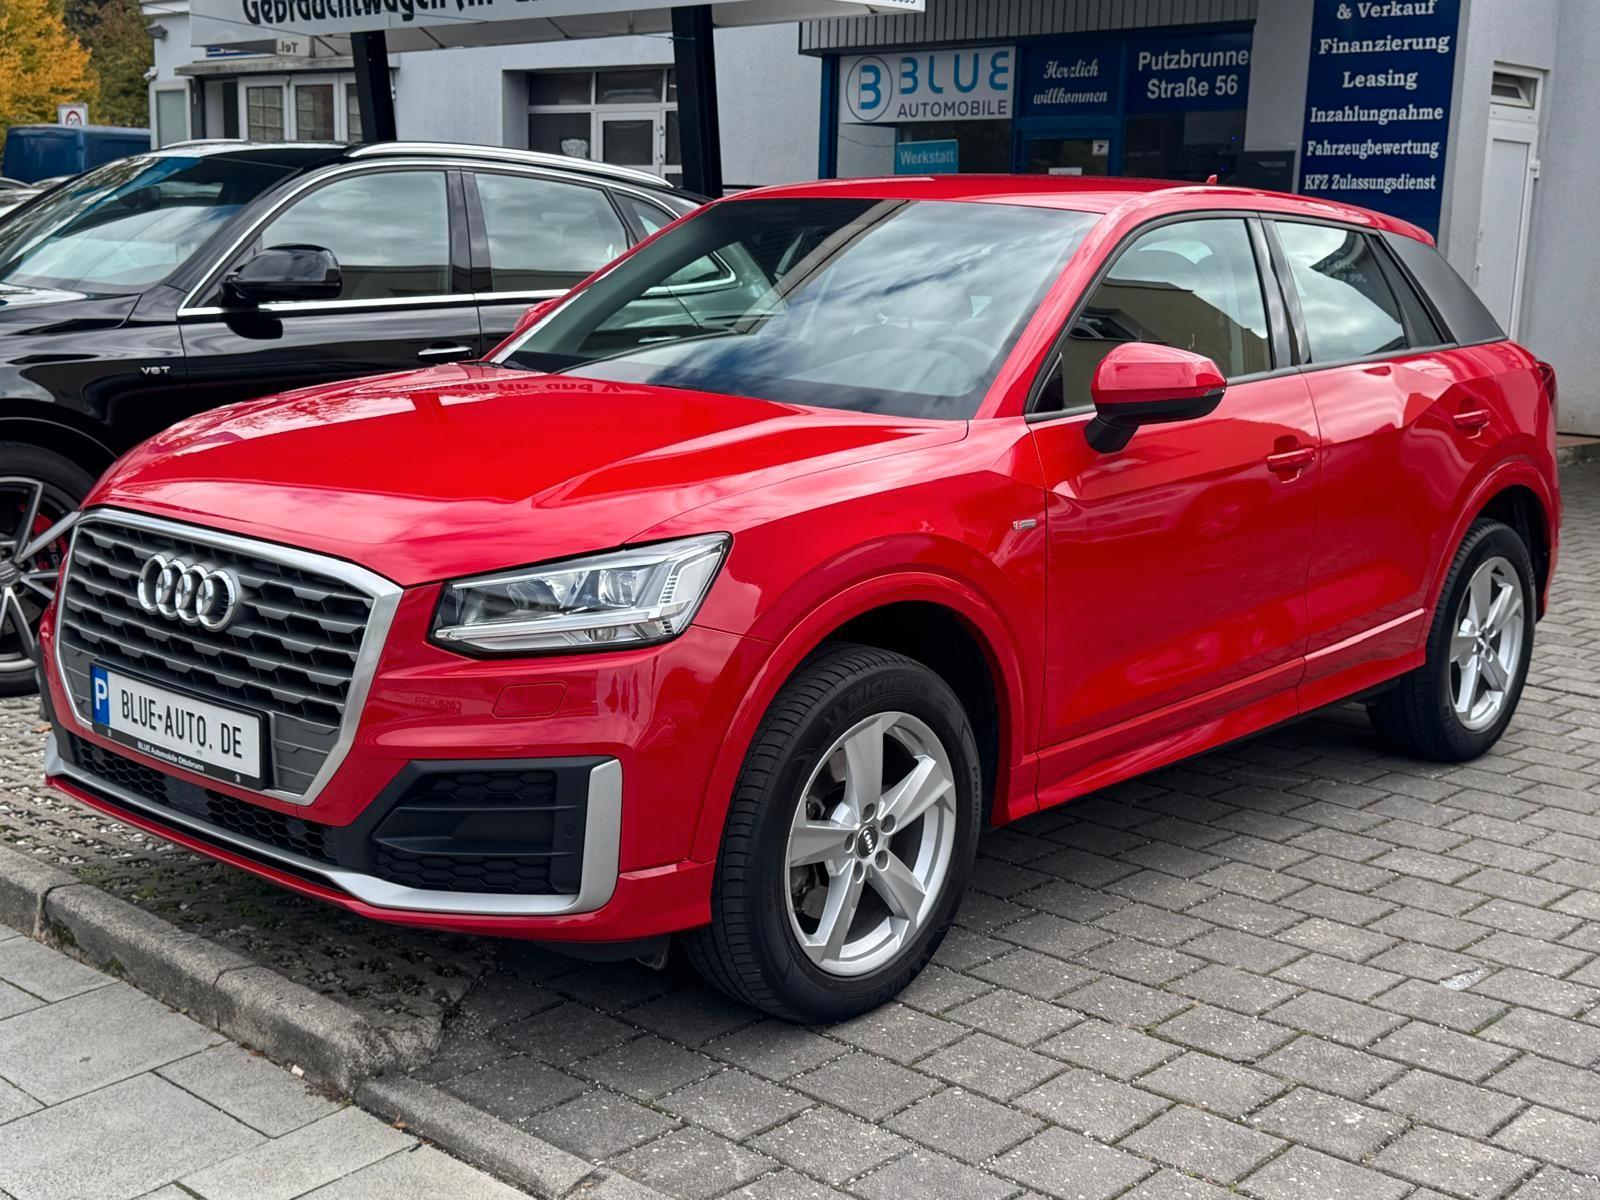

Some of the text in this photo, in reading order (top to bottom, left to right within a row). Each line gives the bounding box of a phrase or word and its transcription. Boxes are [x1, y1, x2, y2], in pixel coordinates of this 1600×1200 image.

[1336, 0, 1437, 19] & Verkauf
[1318, 35, 1451, 55] Finanzierung
[1043, 58, 1099, 79] Herzlich
[1138, 48, 1250, 71] Putzbrunne
[899, 50, 1010, 95] BLUE
[1342, 70, 1419, 90] Leasing
[1033, 87, 1108, 105] willkommen
[1147, 74, 1239, 99] Straße 56
[897, 99, 1008, 119] AUTOMOBILE
[1310, 104, 1444, 125] Inzahlungnahme
[900, 149, 955, 166] Werkstatt
[1306, 139, 1440, 160] Fahrzeugbewertung
[1304, 173, 1437, 194] KFZ Zulassungsdienst
[94, 677, 108, 710] P
